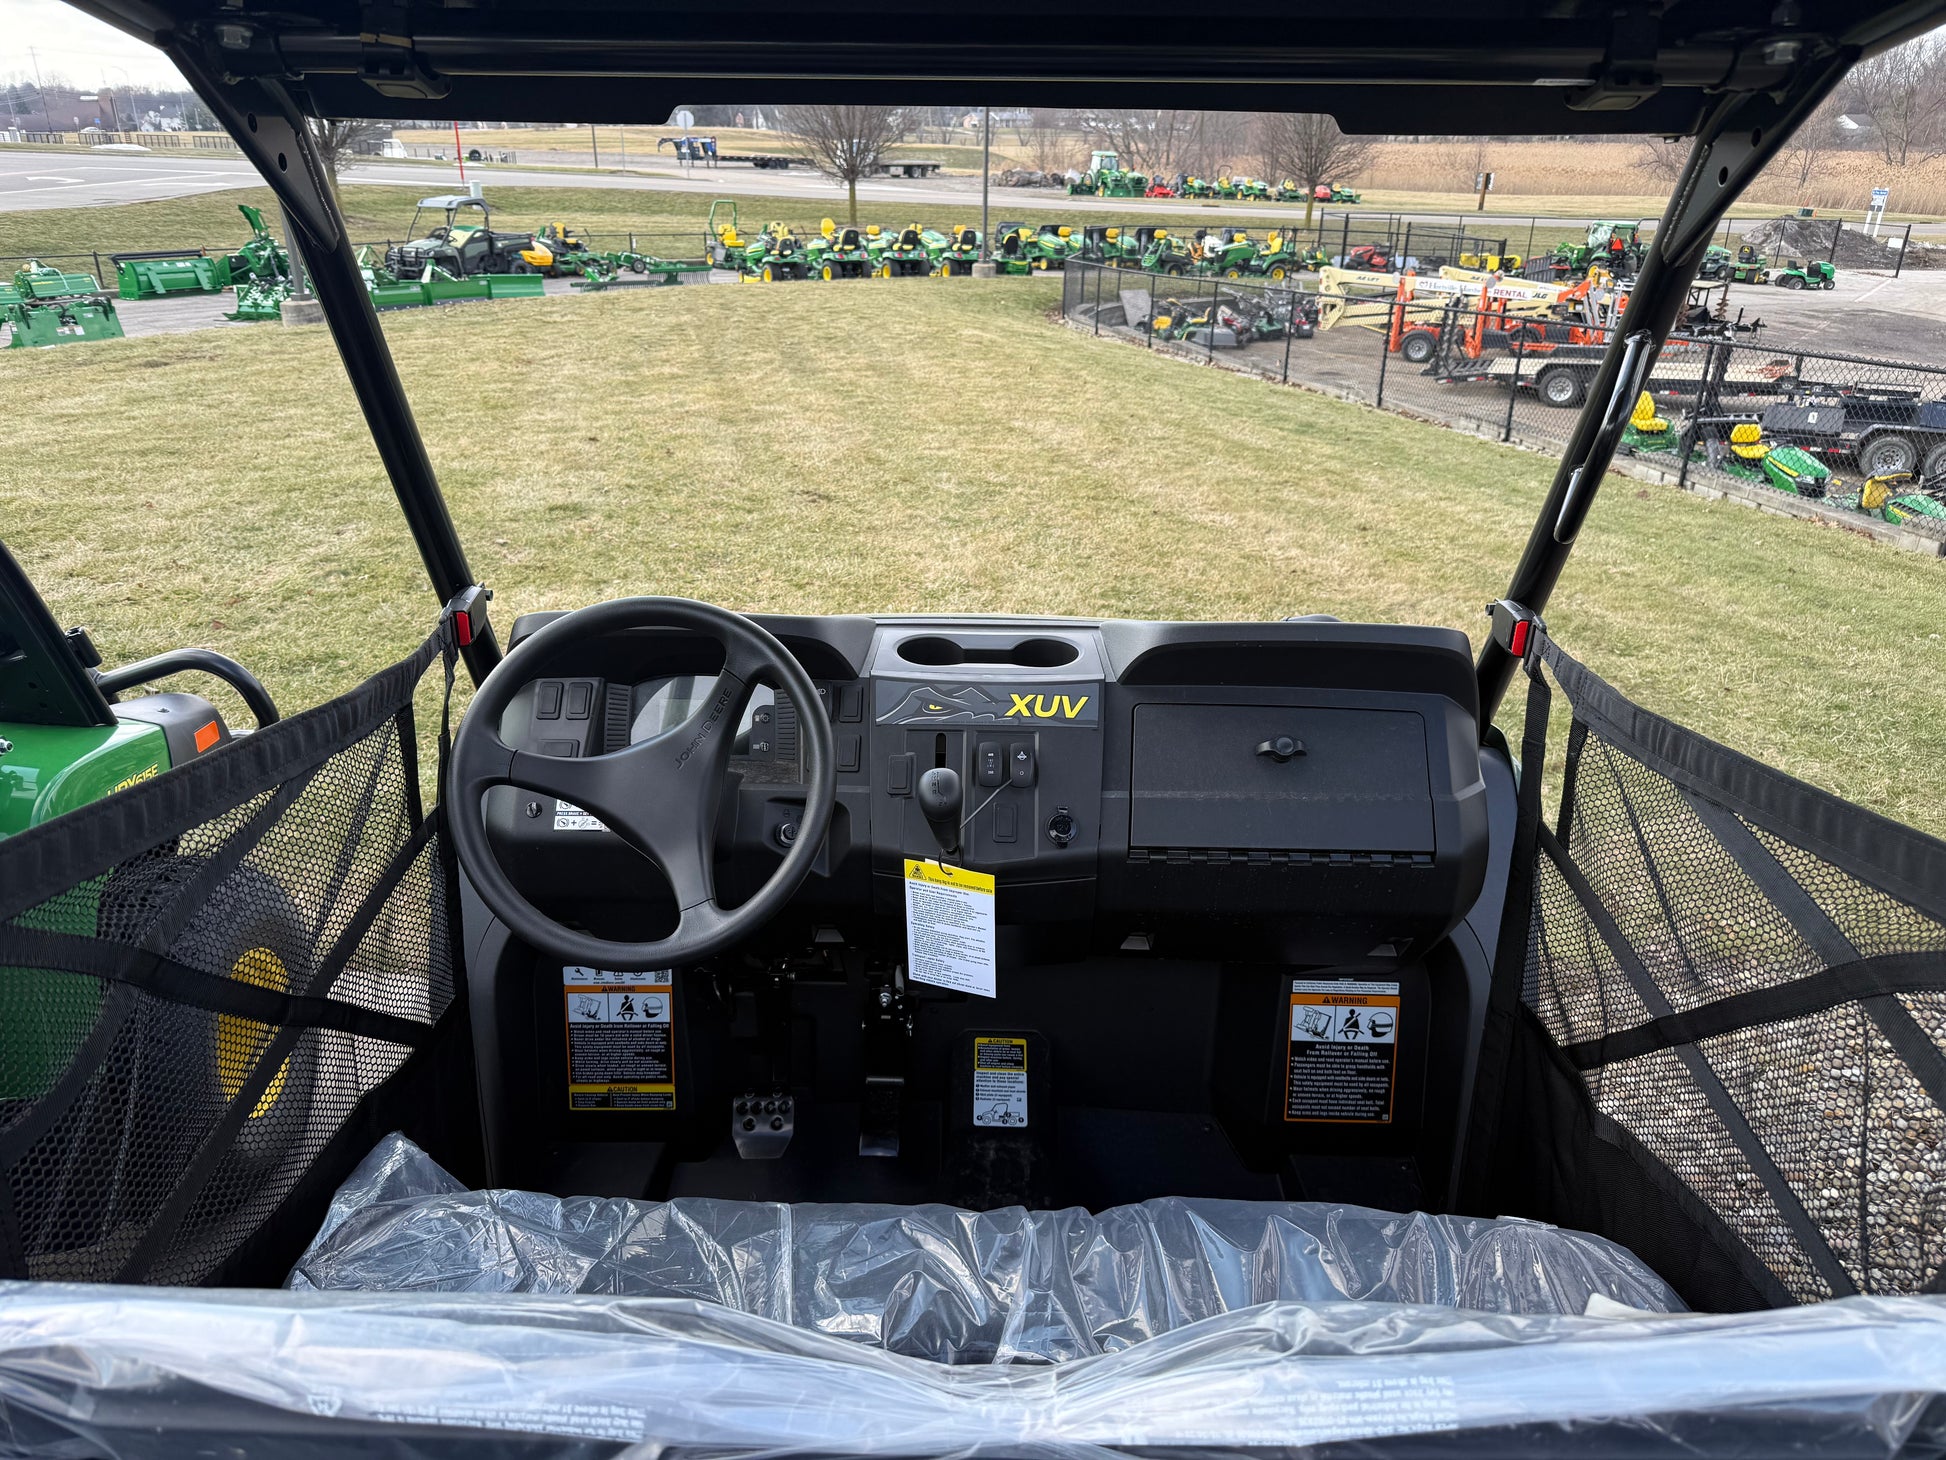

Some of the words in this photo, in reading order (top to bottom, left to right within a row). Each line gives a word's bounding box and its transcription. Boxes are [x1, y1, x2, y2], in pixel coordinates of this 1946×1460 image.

[1493, 288, 1527, 298] RENTAL
[1003, 693, 1090, 719] XUV
[674, 732, 706, 770] JOHN
[702, 688, 733, 734] DEERE
